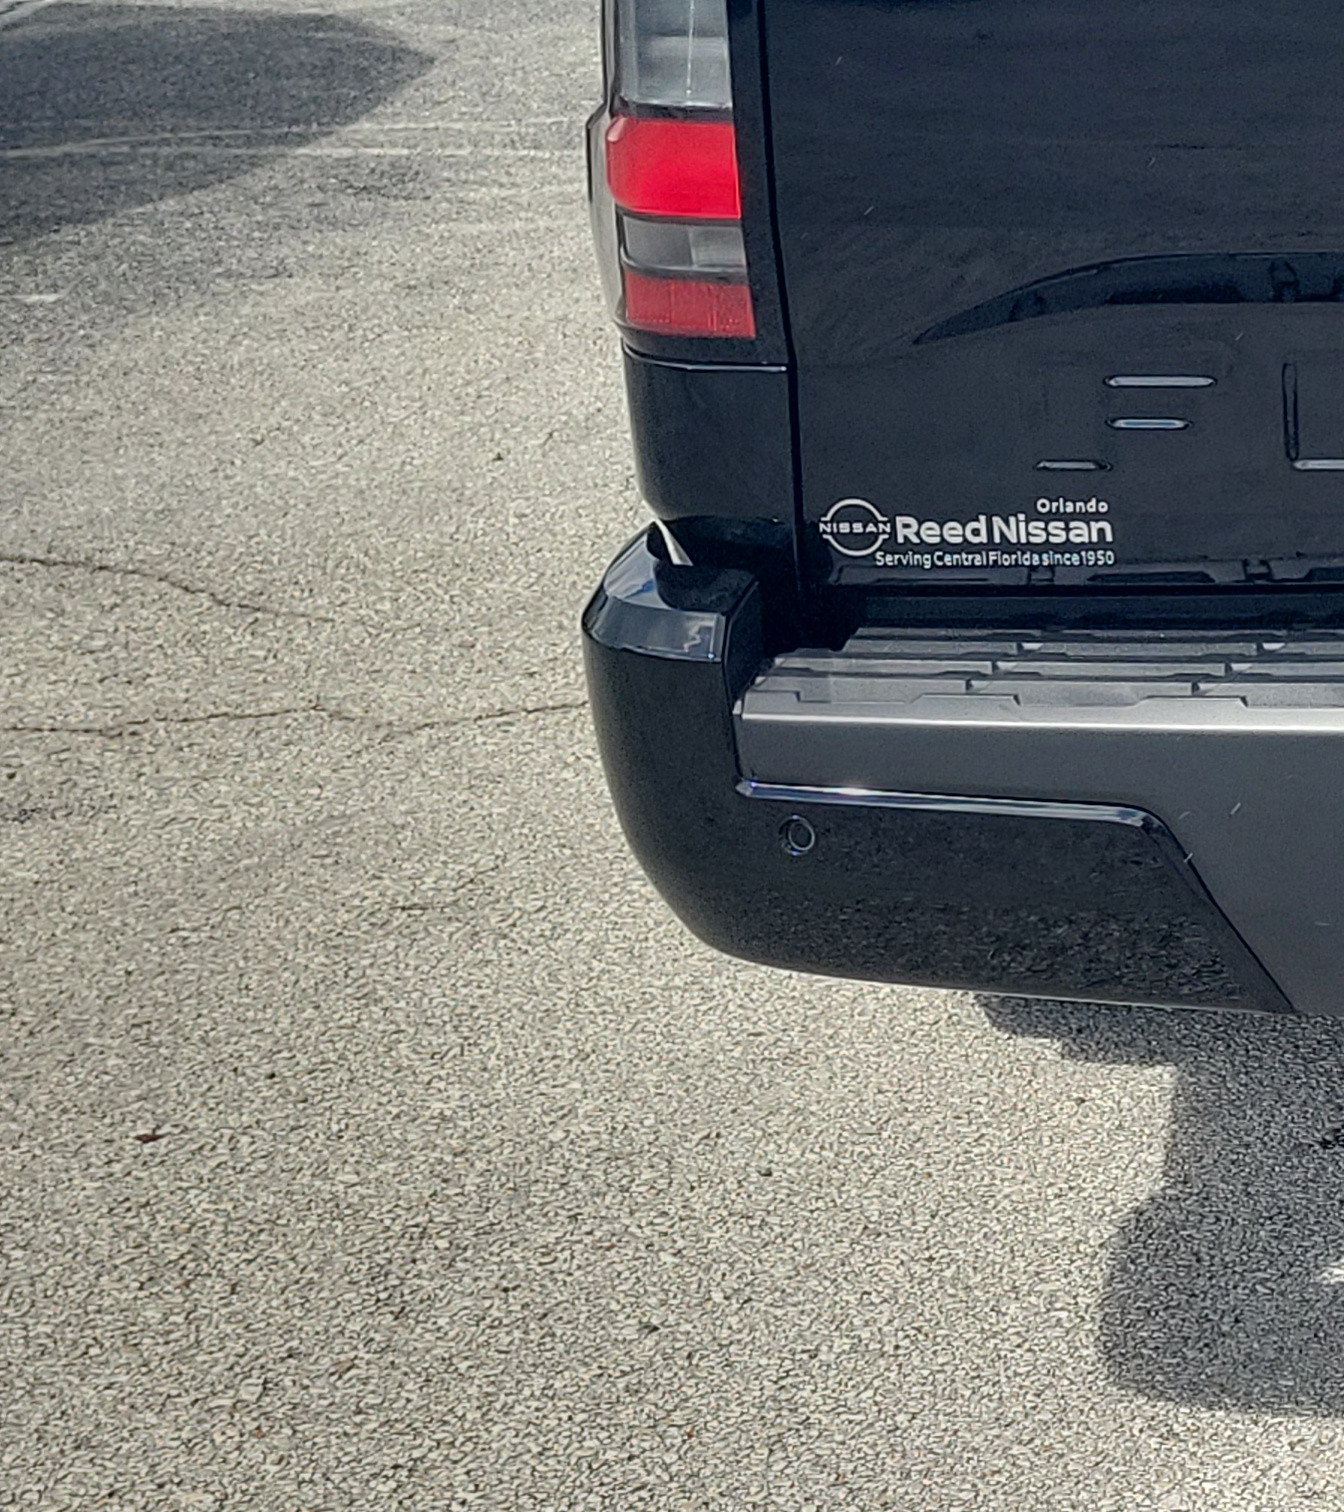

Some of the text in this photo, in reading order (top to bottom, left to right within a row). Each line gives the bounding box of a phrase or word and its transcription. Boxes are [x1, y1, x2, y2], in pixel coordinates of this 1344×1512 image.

[1036, 498, 1108, 514] Orlando
[819, 521, 892, 534] NISSAN
[895, 514, 1113, 544] Reed Nissan
[875, 551, 1115, 569] Serving Central Florida since 1950
